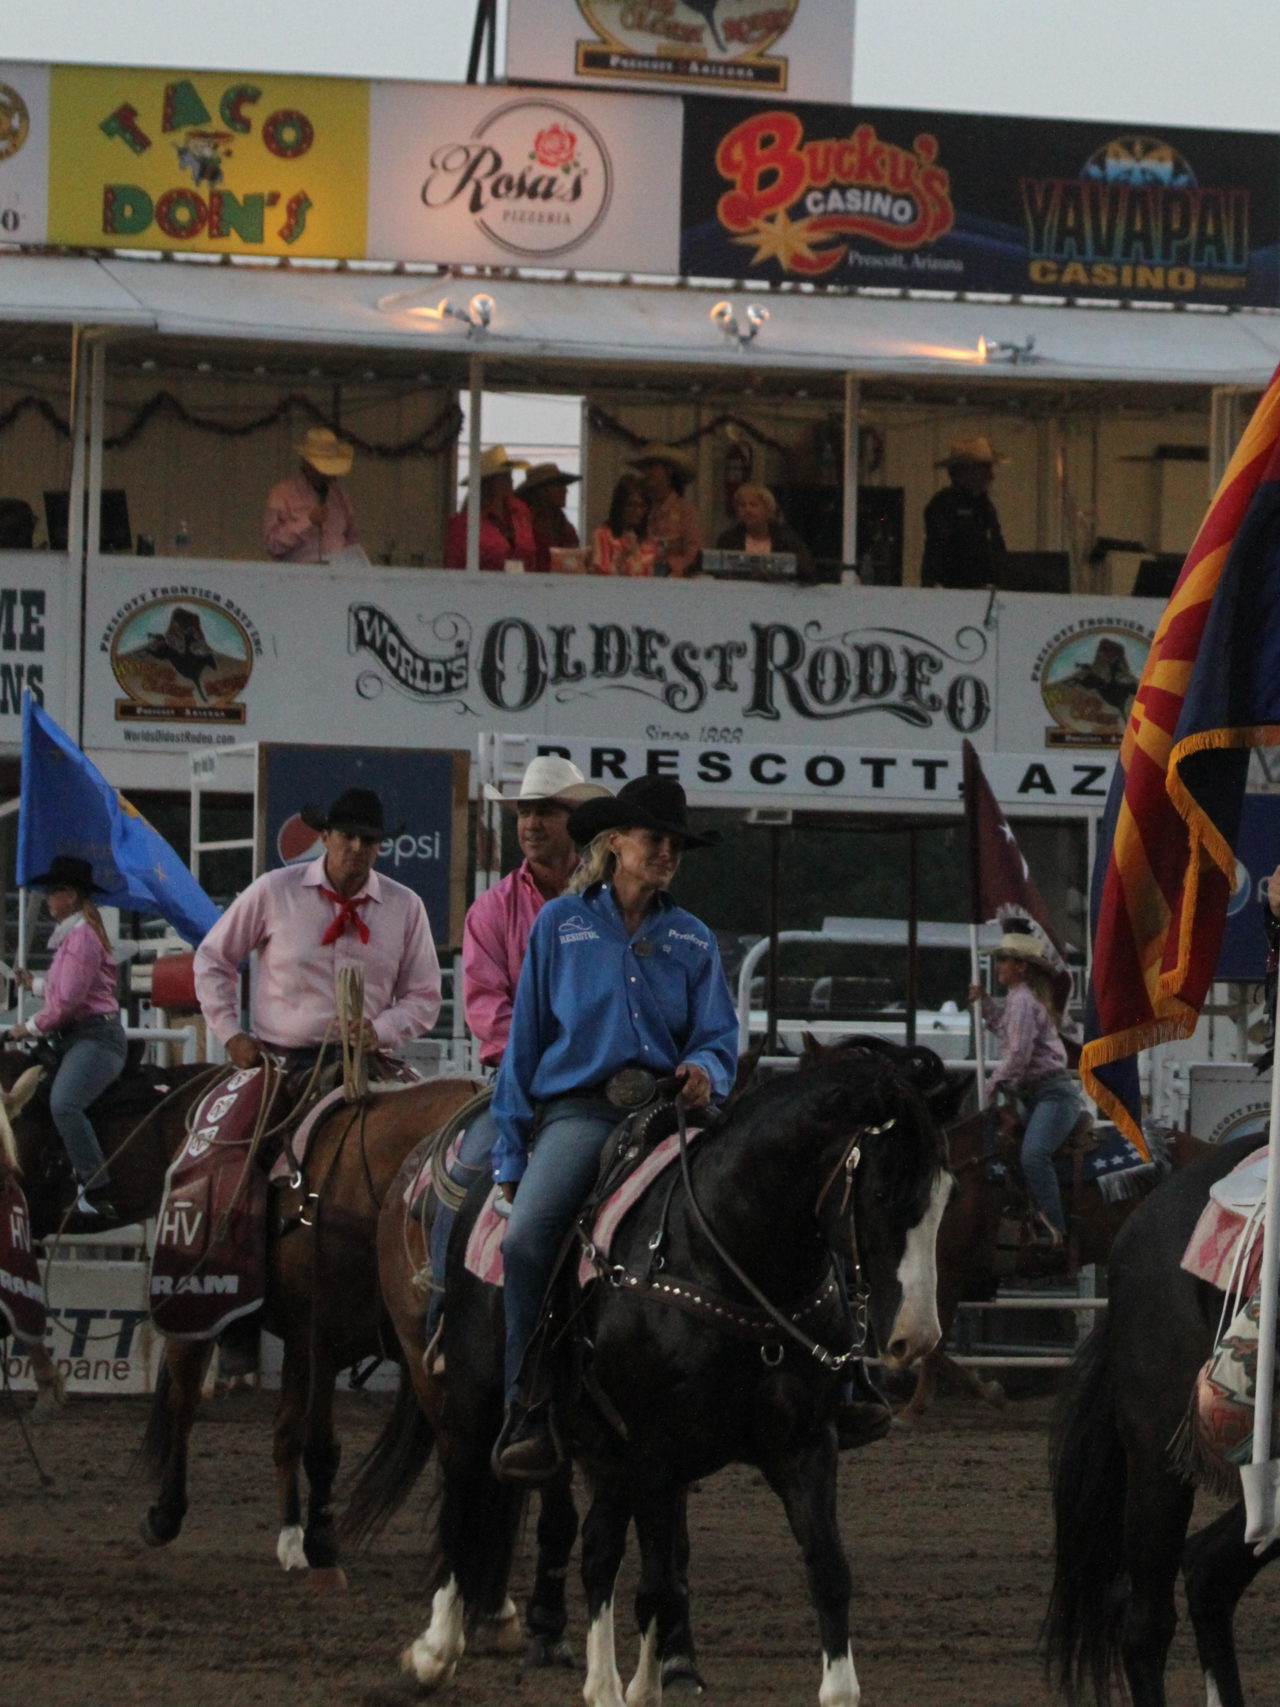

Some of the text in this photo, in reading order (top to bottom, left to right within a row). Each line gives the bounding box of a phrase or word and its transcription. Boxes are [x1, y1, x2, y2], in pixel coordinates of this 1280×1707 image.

[100, 79, 314, 160] TACO
[420, 143, 588, 214] Rosa's
[715, 110, 955, 250] Bucky's
[804, 187, 914, 223] CASINO
[103, 184, 313, 244] DON'S
[503, 209, 571, 224] PIZZERIA
[1020, 176, 1252, 272] YAVAPAI
[1028, 259, 1198, 291] CASINO
[479, 616, 747, 713] OLDEST
[742, 622, 990, 733] RODEO
[376, 830, 440, 867] epsi
[151, 1274, 240, 1295] RAM
